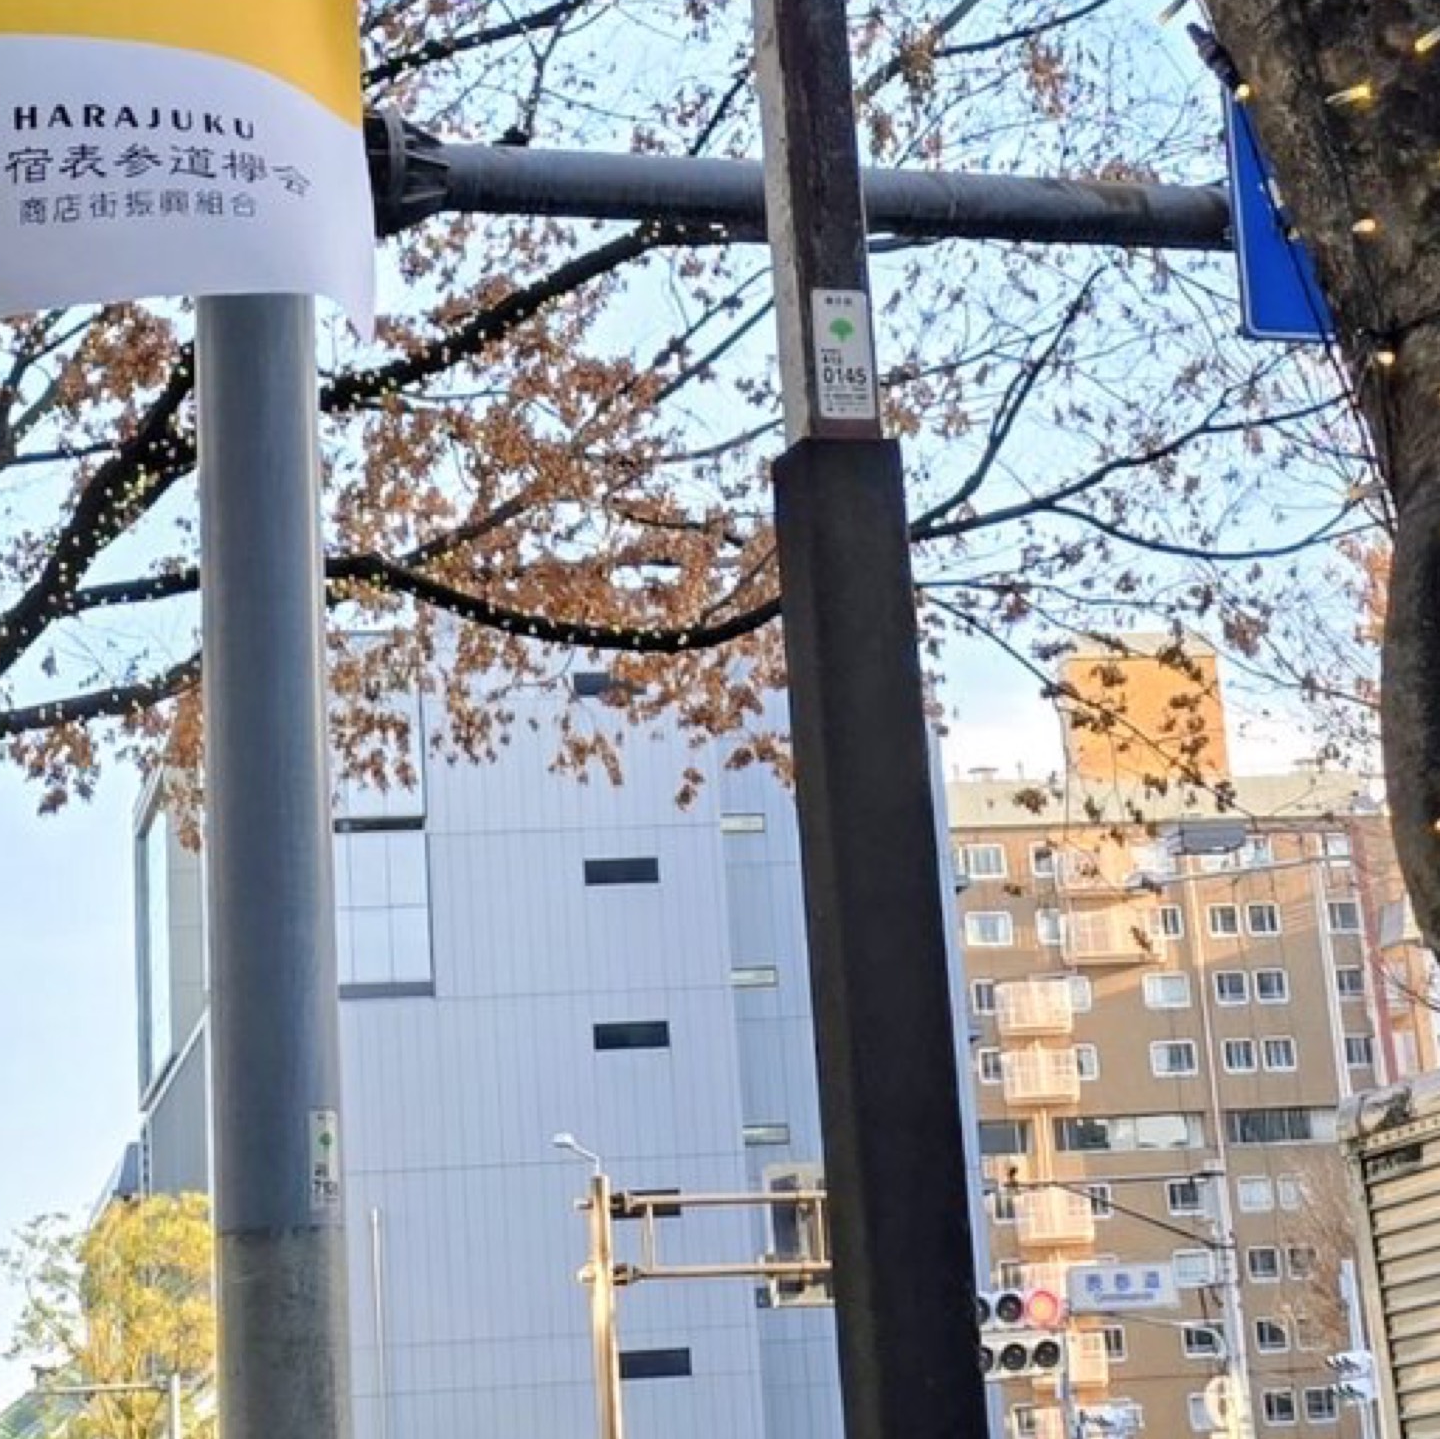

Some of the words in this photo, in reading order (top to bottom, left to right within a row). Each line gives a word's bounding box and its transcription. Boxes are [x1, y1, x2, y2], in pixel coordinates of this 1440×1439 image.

[13, 104, 256, 141] HARAJUKU
[18, 189, 258, 226] 商店街振興組合
